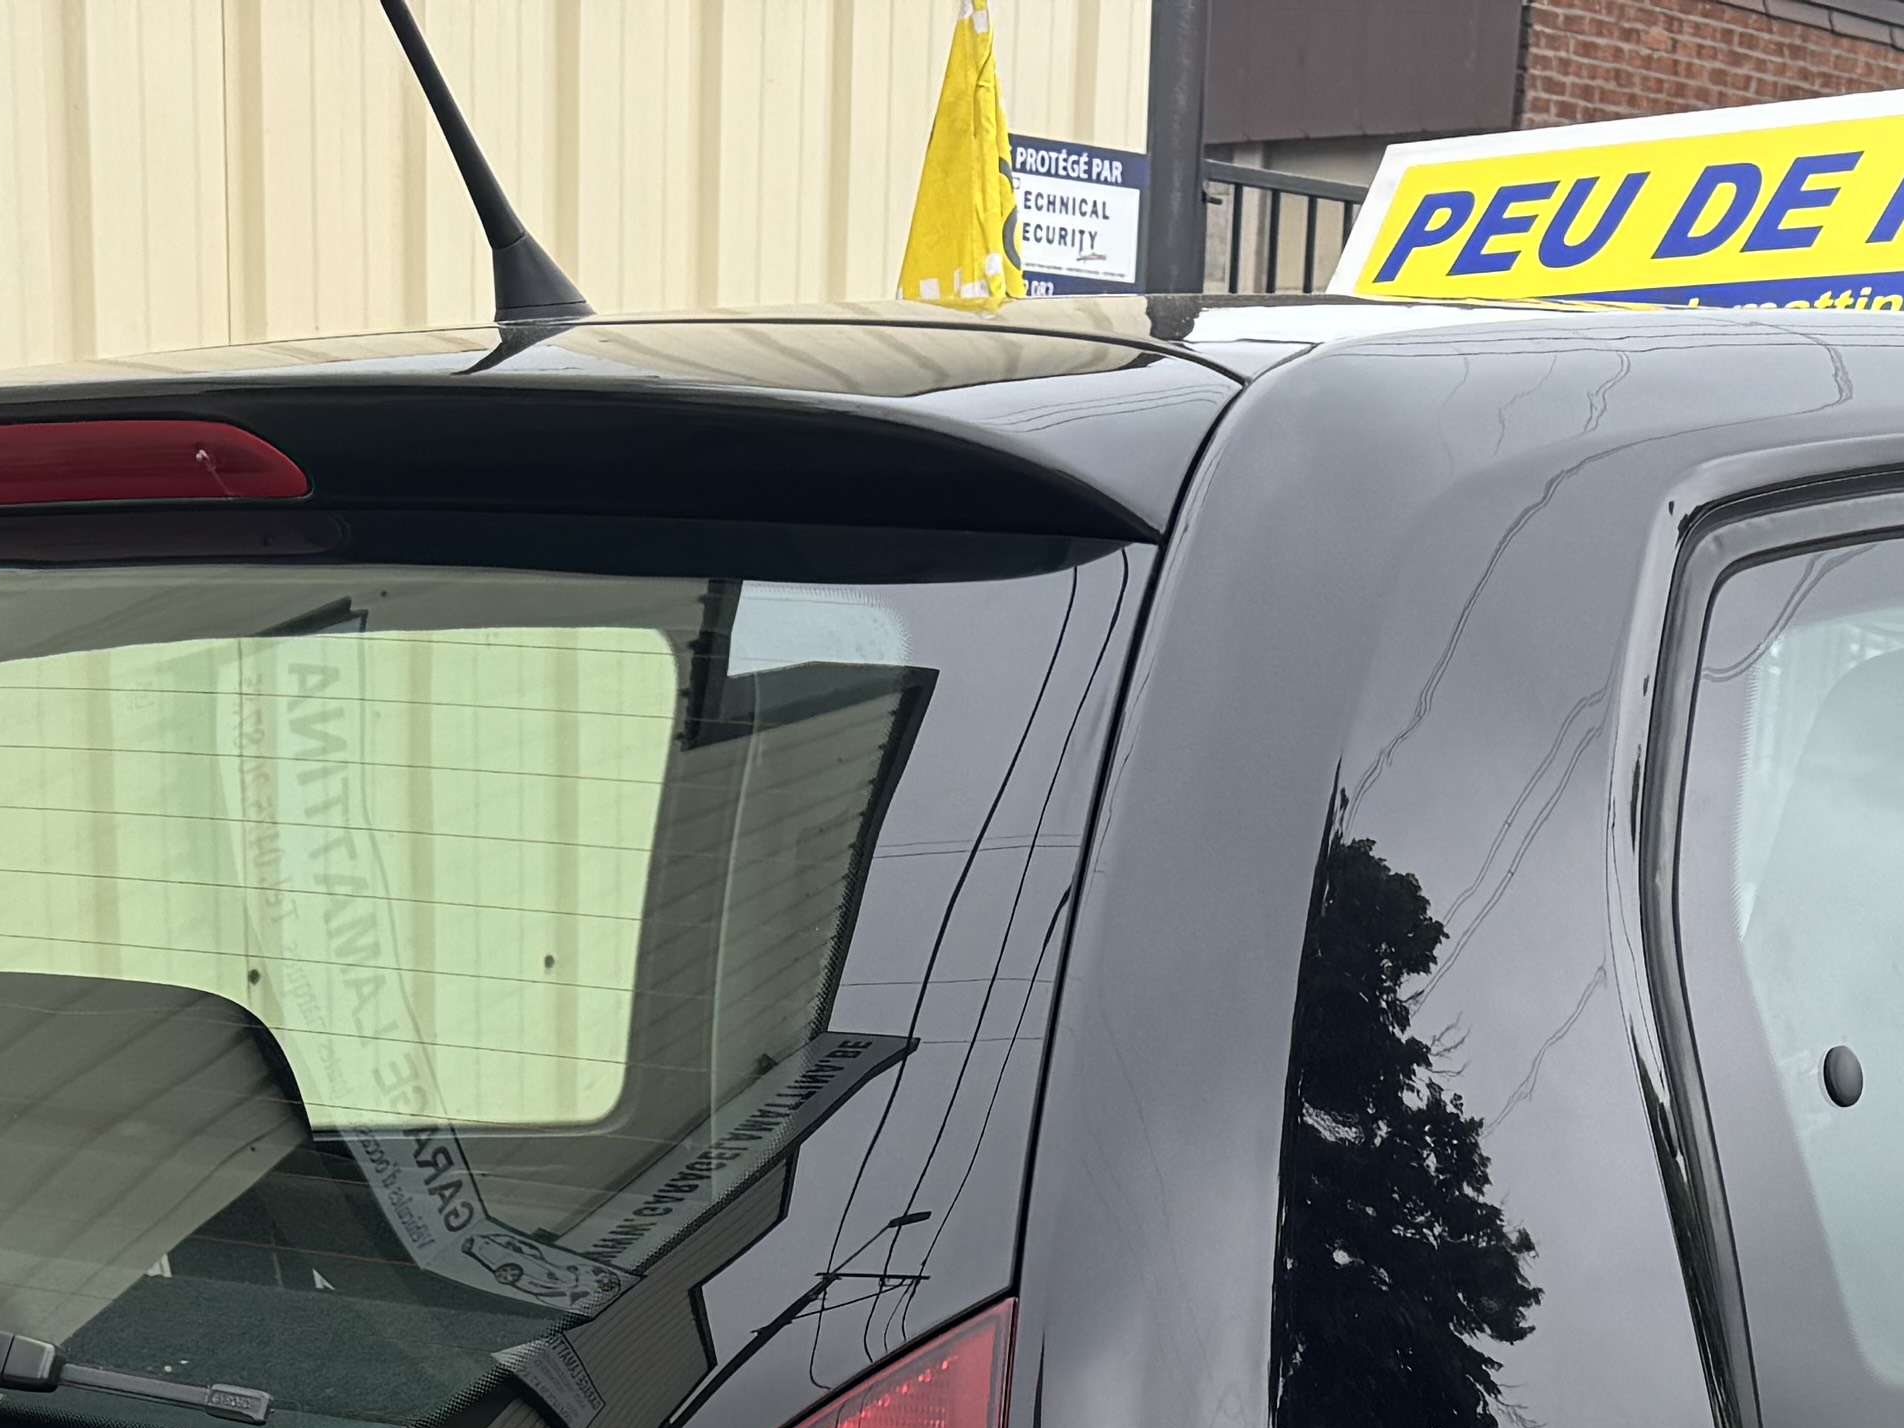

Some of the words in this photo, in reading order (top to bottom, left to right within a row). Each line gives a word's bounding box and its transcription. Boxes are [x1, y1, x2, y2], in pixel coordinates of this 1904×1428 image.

[1015, 147, 1089, 180] PROTÉGÉ
[1091, 157, 1124, 184] PAR
[1023, 190, 1110, 220] ECHNICAL
[1372, 170, 1651, 284] PEU
[1651, 149, 1865, 261] DE
[1022, 222, 1098, 253] ECURITY
